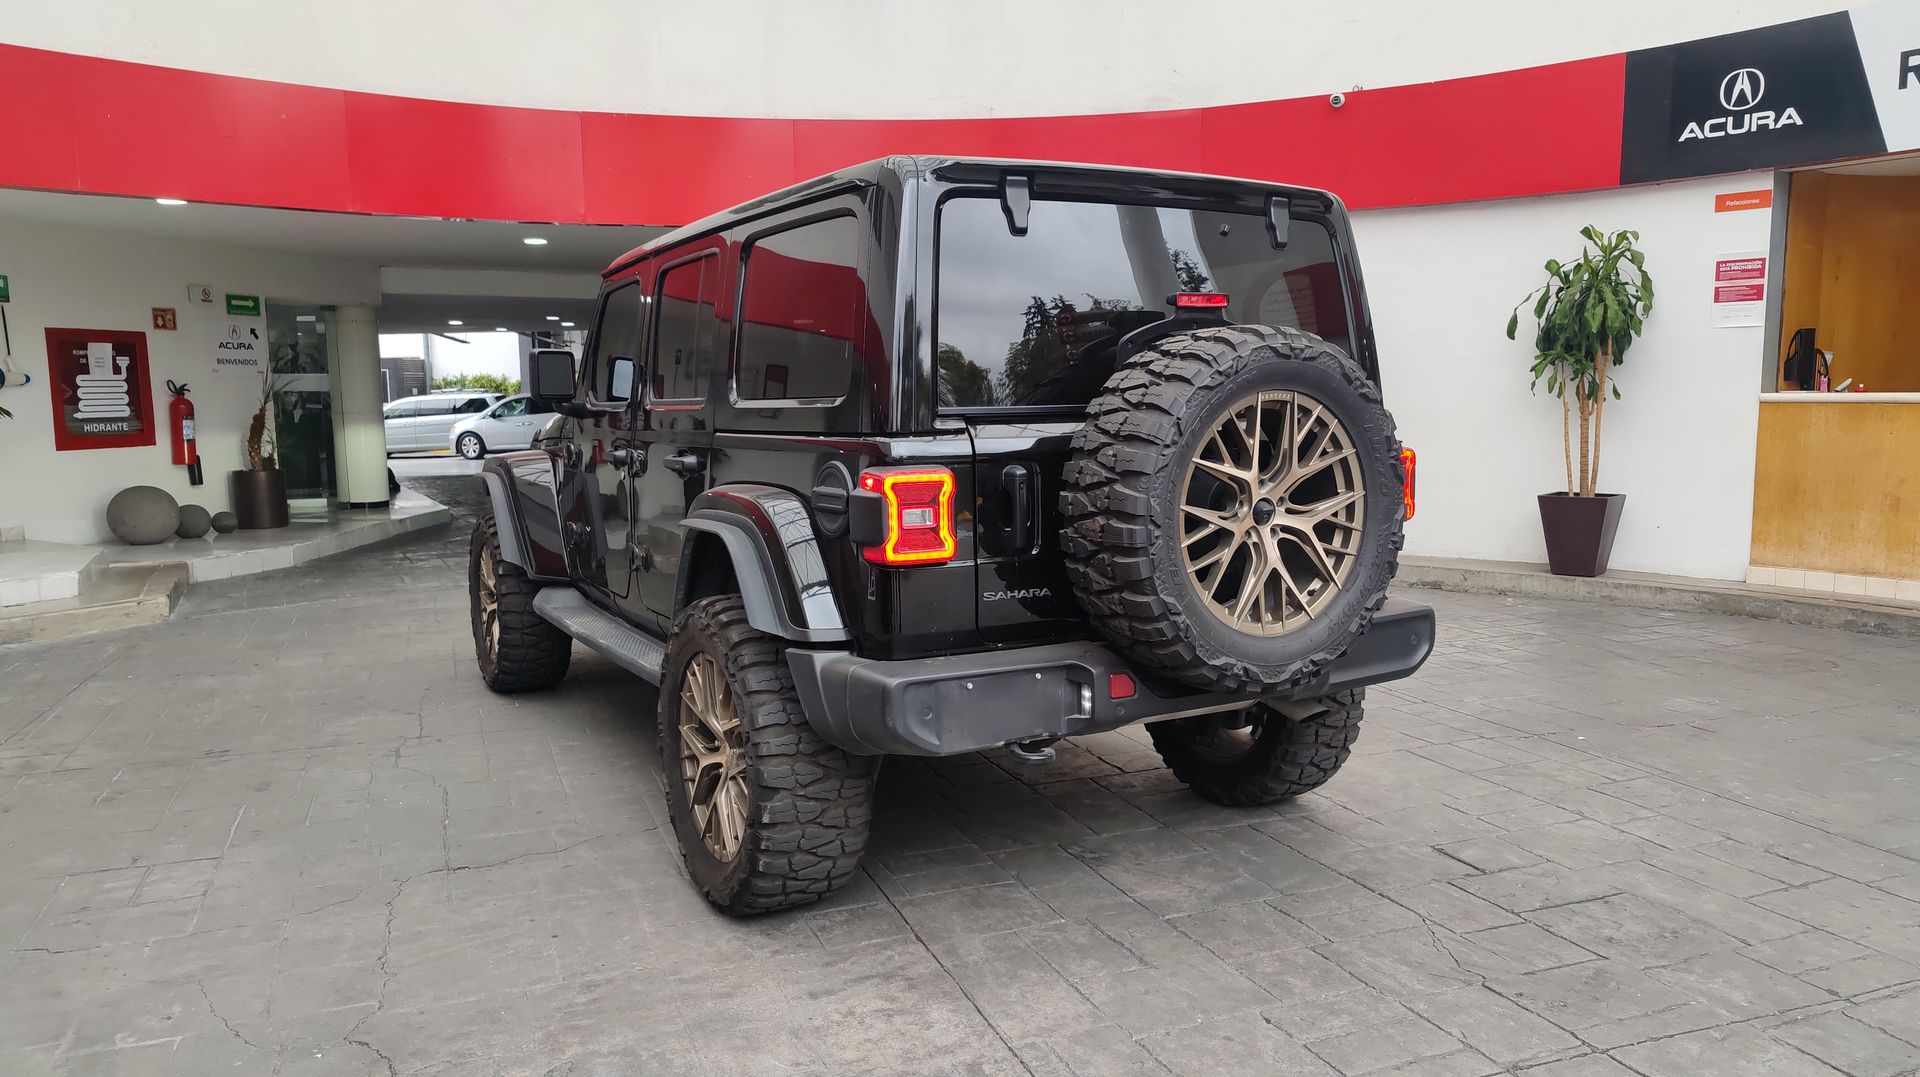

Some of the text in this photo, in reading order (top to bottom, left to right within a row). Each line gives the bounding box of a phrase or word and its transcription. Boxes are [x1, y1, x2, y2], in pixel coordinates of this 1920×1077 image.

[1678, 107, 1804, 142] ACURA
[218, 341, 254, 350] ACURA
[216, 358, 258, 366] BIENVENIDOS
[84, 422, 129, 432] HIDRANTE
[982, 588, 1052, 601] SAHARA
